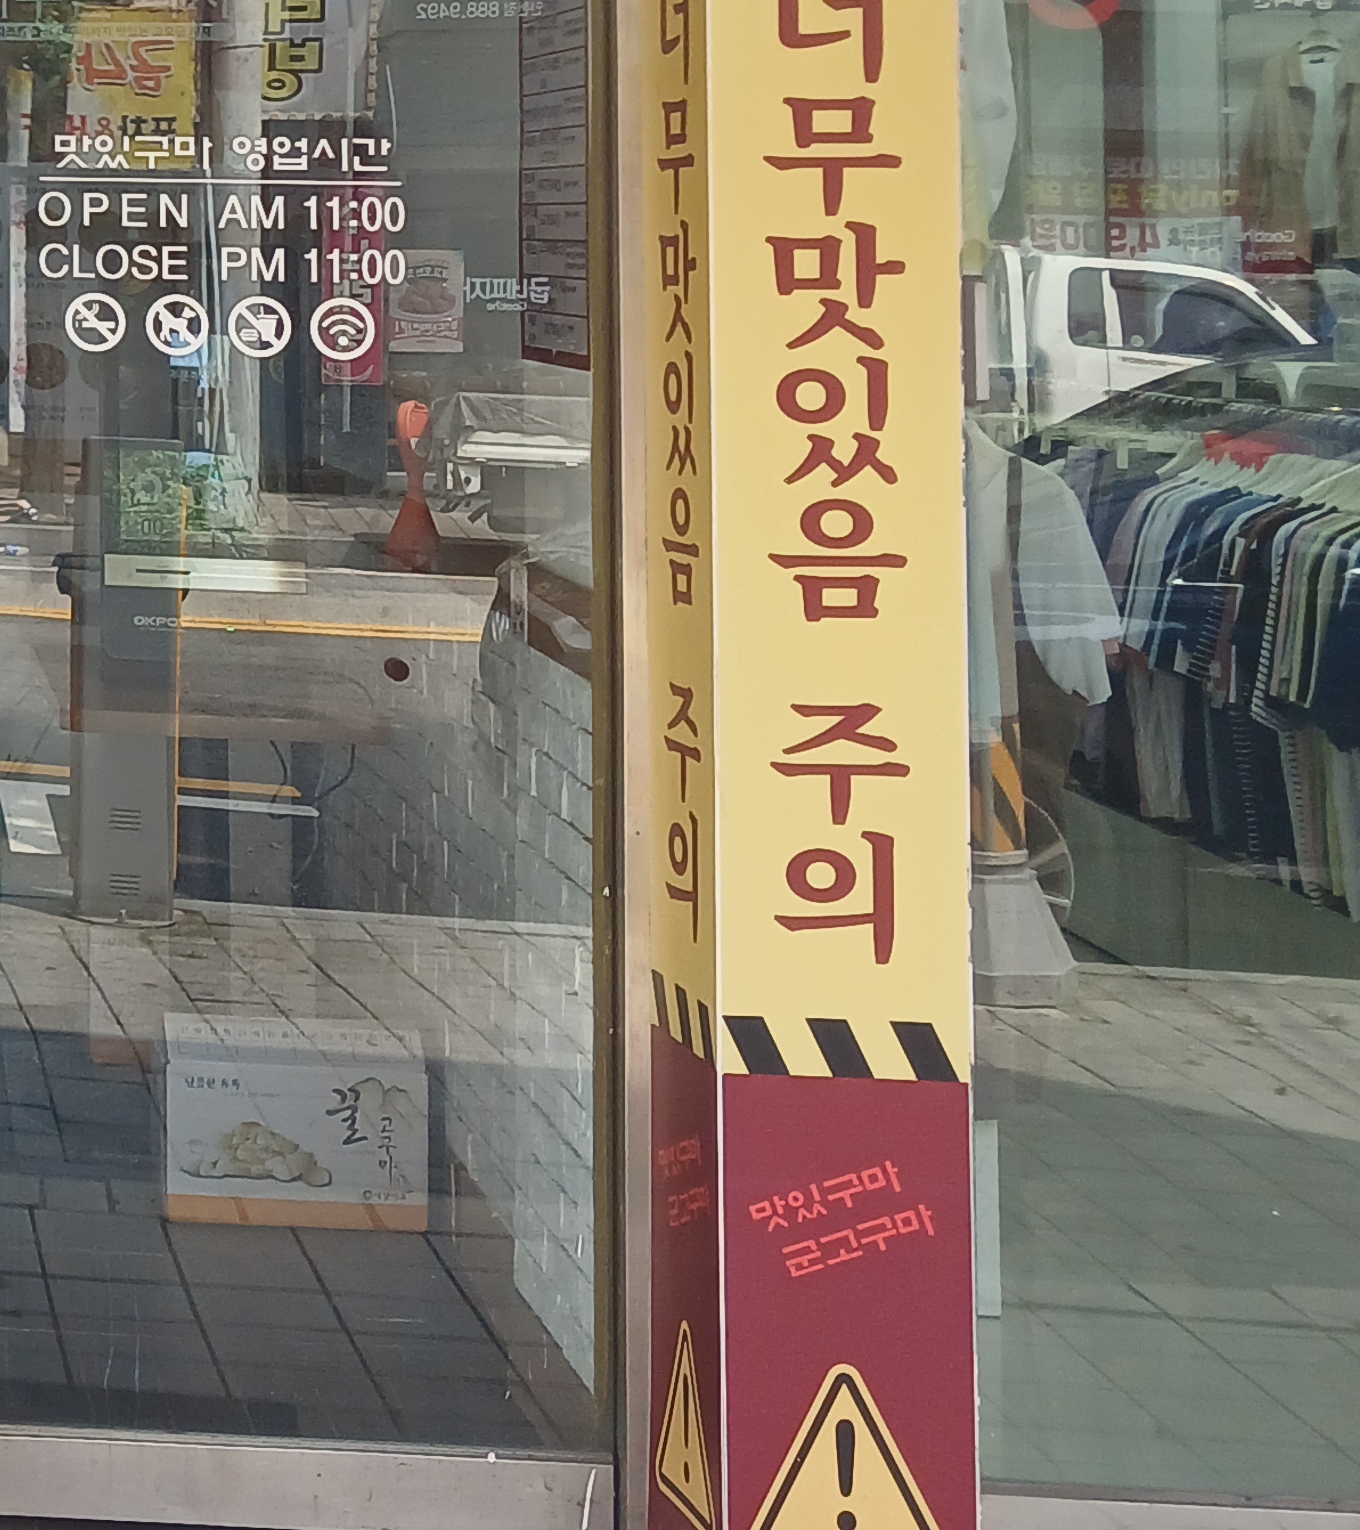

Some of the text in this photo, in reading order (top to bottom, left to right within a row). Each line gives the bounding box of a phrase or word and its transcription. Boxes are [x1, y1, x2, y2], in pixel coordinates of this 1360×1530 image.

[53, 134, 393, 173] 맛있구마 영업시간
[37, 191, 406, 233] OPEN AM 11:00
[37, 242, 189, 281] CLOSE
[220, 247, 286, 283] PM
[303, 248, 406, 285] 11:00
[664, 679, 703, 945] 주의
[769, 700, 912, 966] 주의
[325, 1086, 370, 1147] 꿀
[748, 1160, 902, 1233] 맛있구마
[781, 1203, 936, 1278] 군고구마
